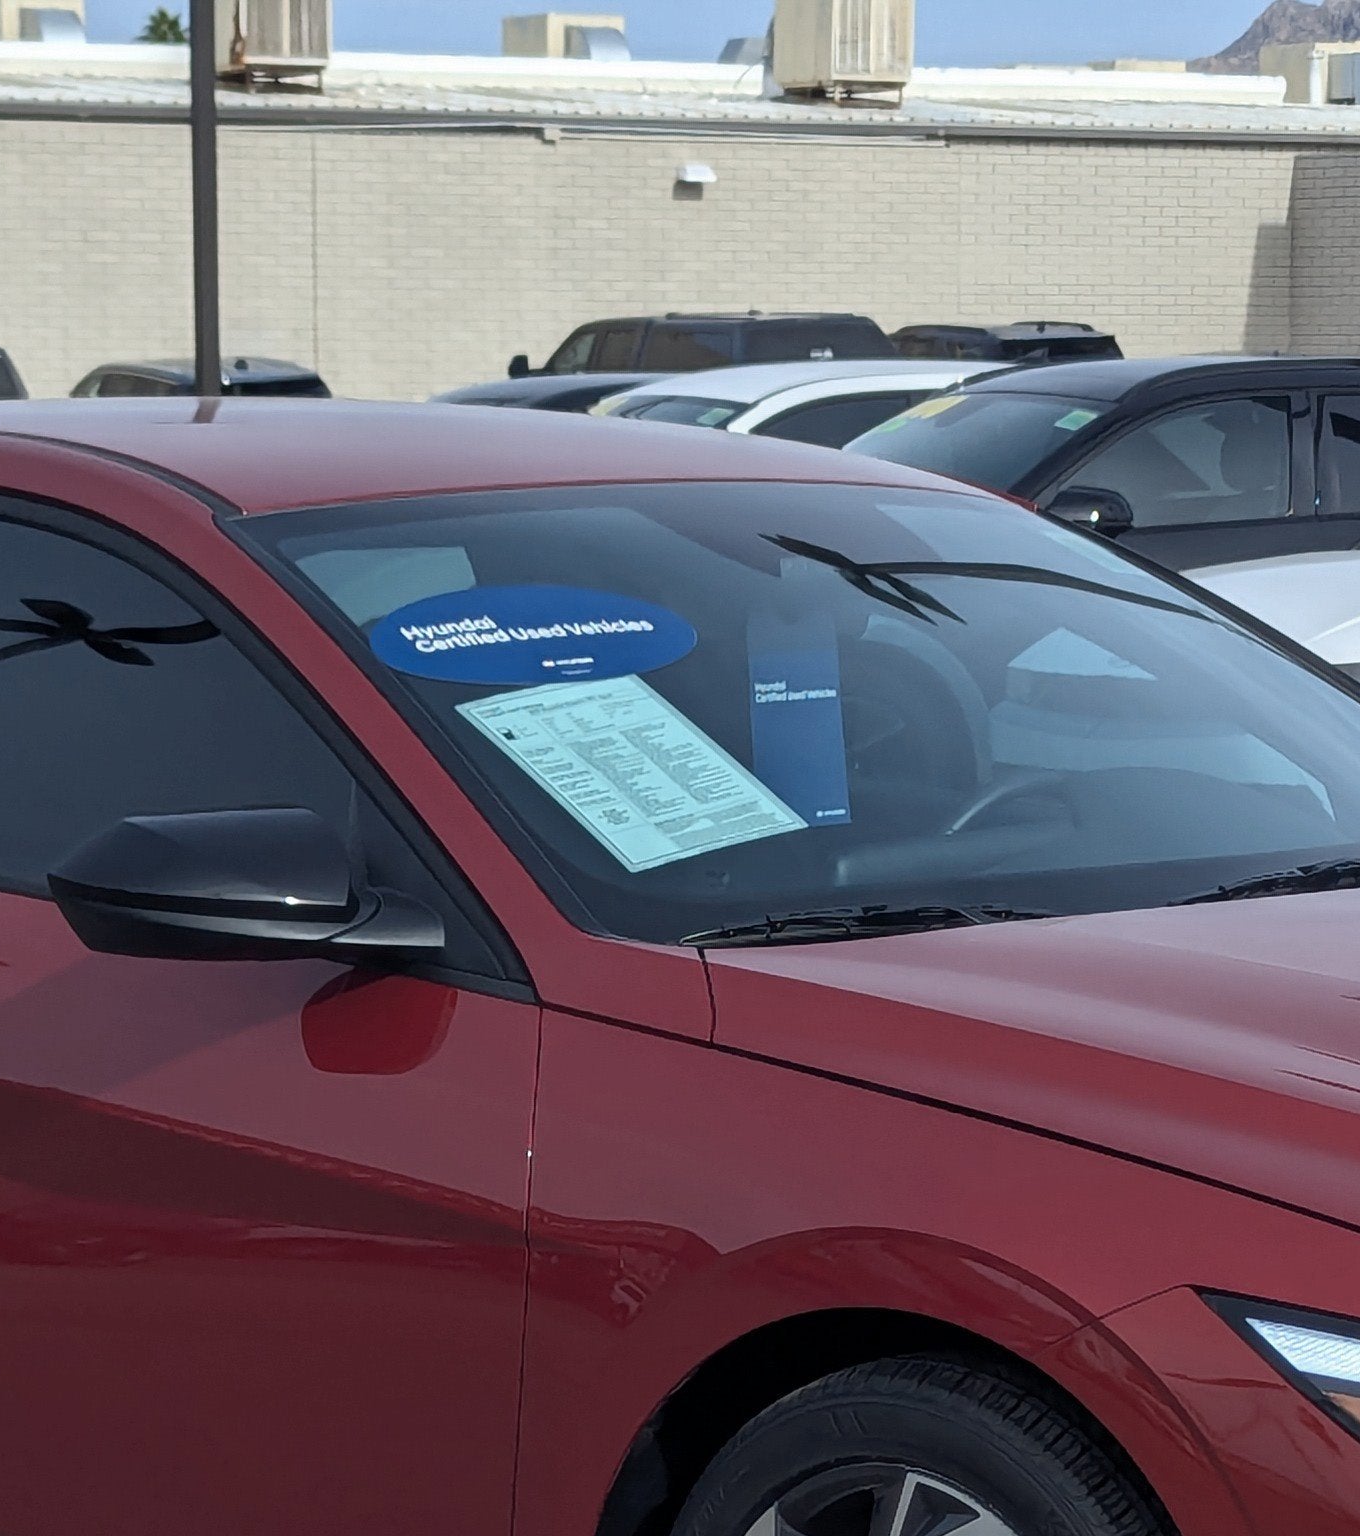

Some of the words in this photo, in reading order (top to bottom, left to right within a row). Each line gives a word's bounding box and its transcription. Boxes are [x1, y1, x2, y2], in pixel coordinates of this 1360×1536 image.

[400, 614, 498, 641] Hyundai
[415, 628, 512, 653] Certified
[508, 622, 567, 641] Used
[563, 618, 654, 636] Vehicles
